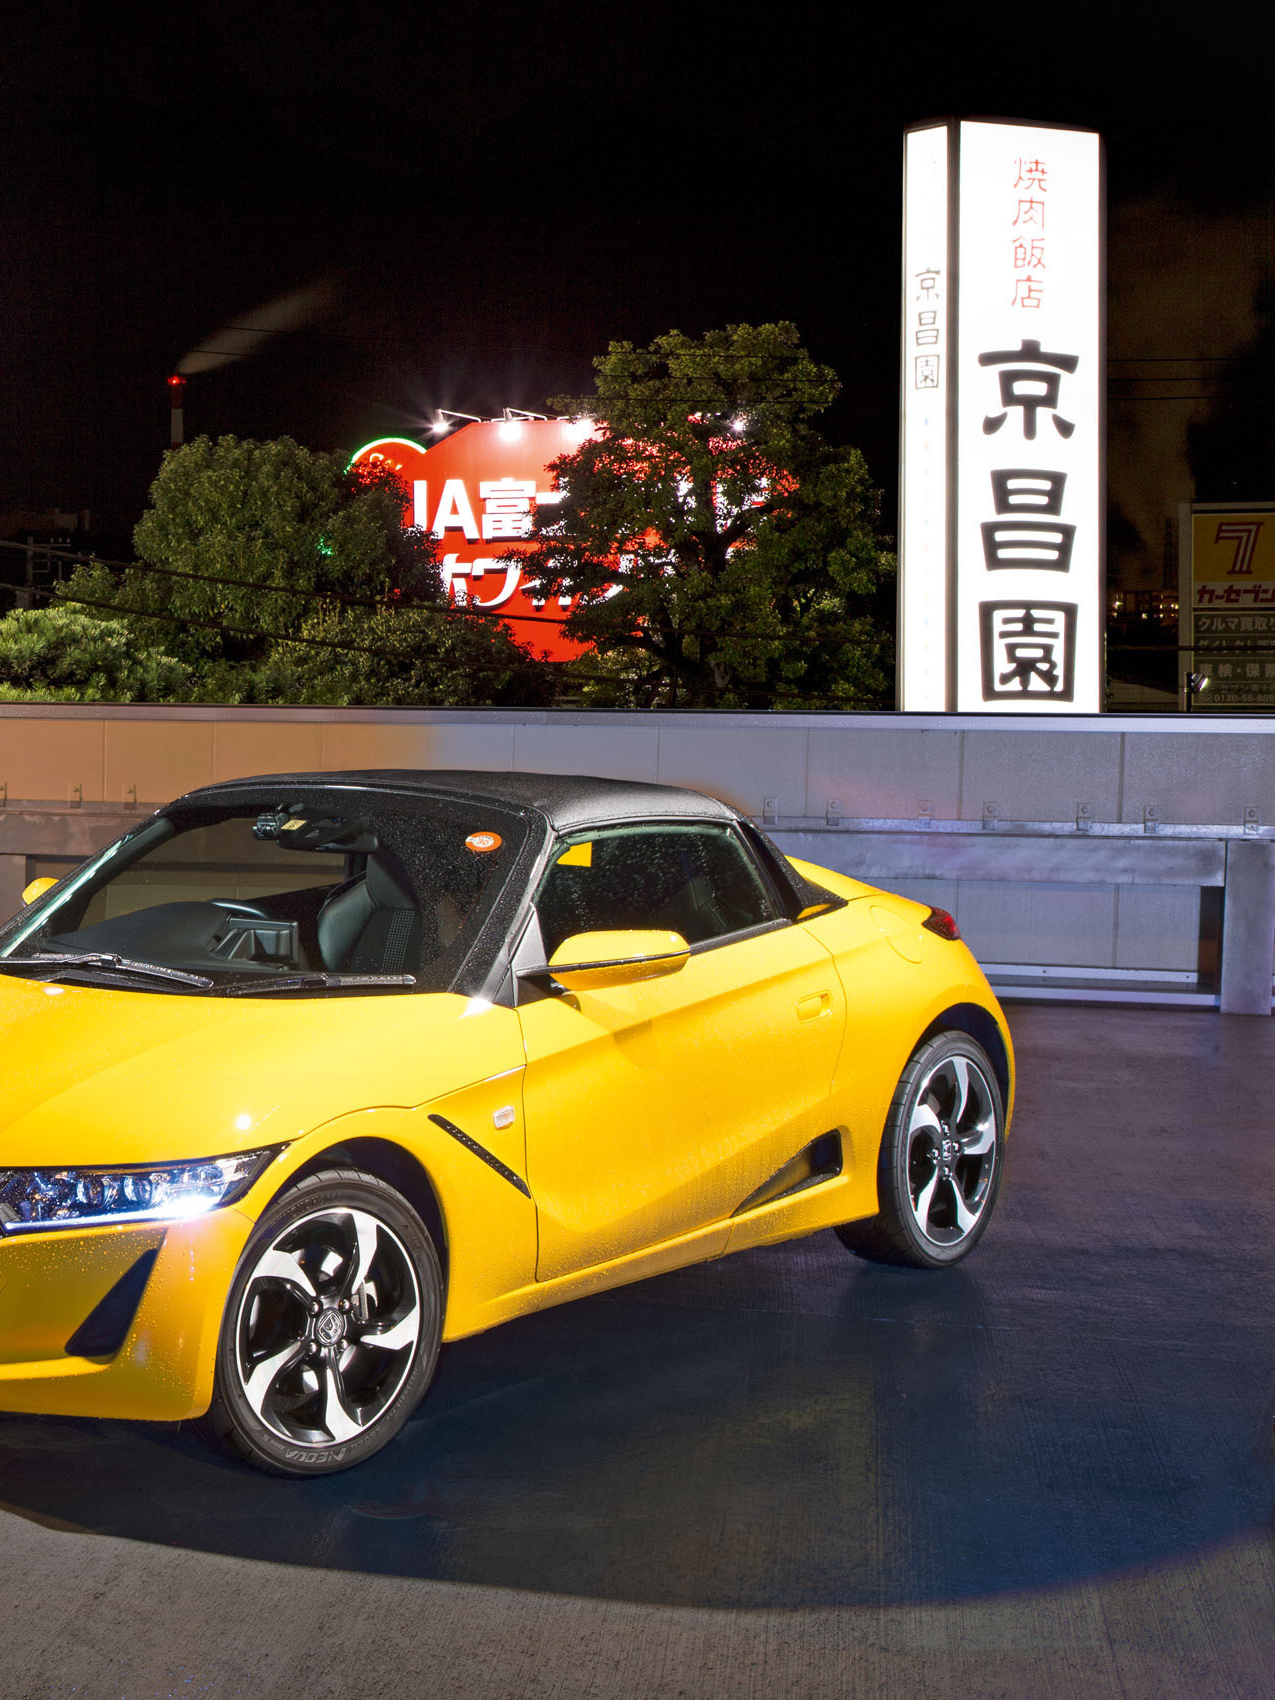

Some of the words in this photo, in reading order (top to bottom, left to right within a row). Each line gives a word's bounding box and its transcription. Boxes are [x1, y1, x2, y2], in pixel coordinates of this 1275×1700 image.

[1011, 156, 1048, 309] 焼肉飯店
[914, 267, 942, 390] 京昌園
[977, 338, 1080, 703] 京昌園
[285, 1447, 347, 1464] NEOVA
